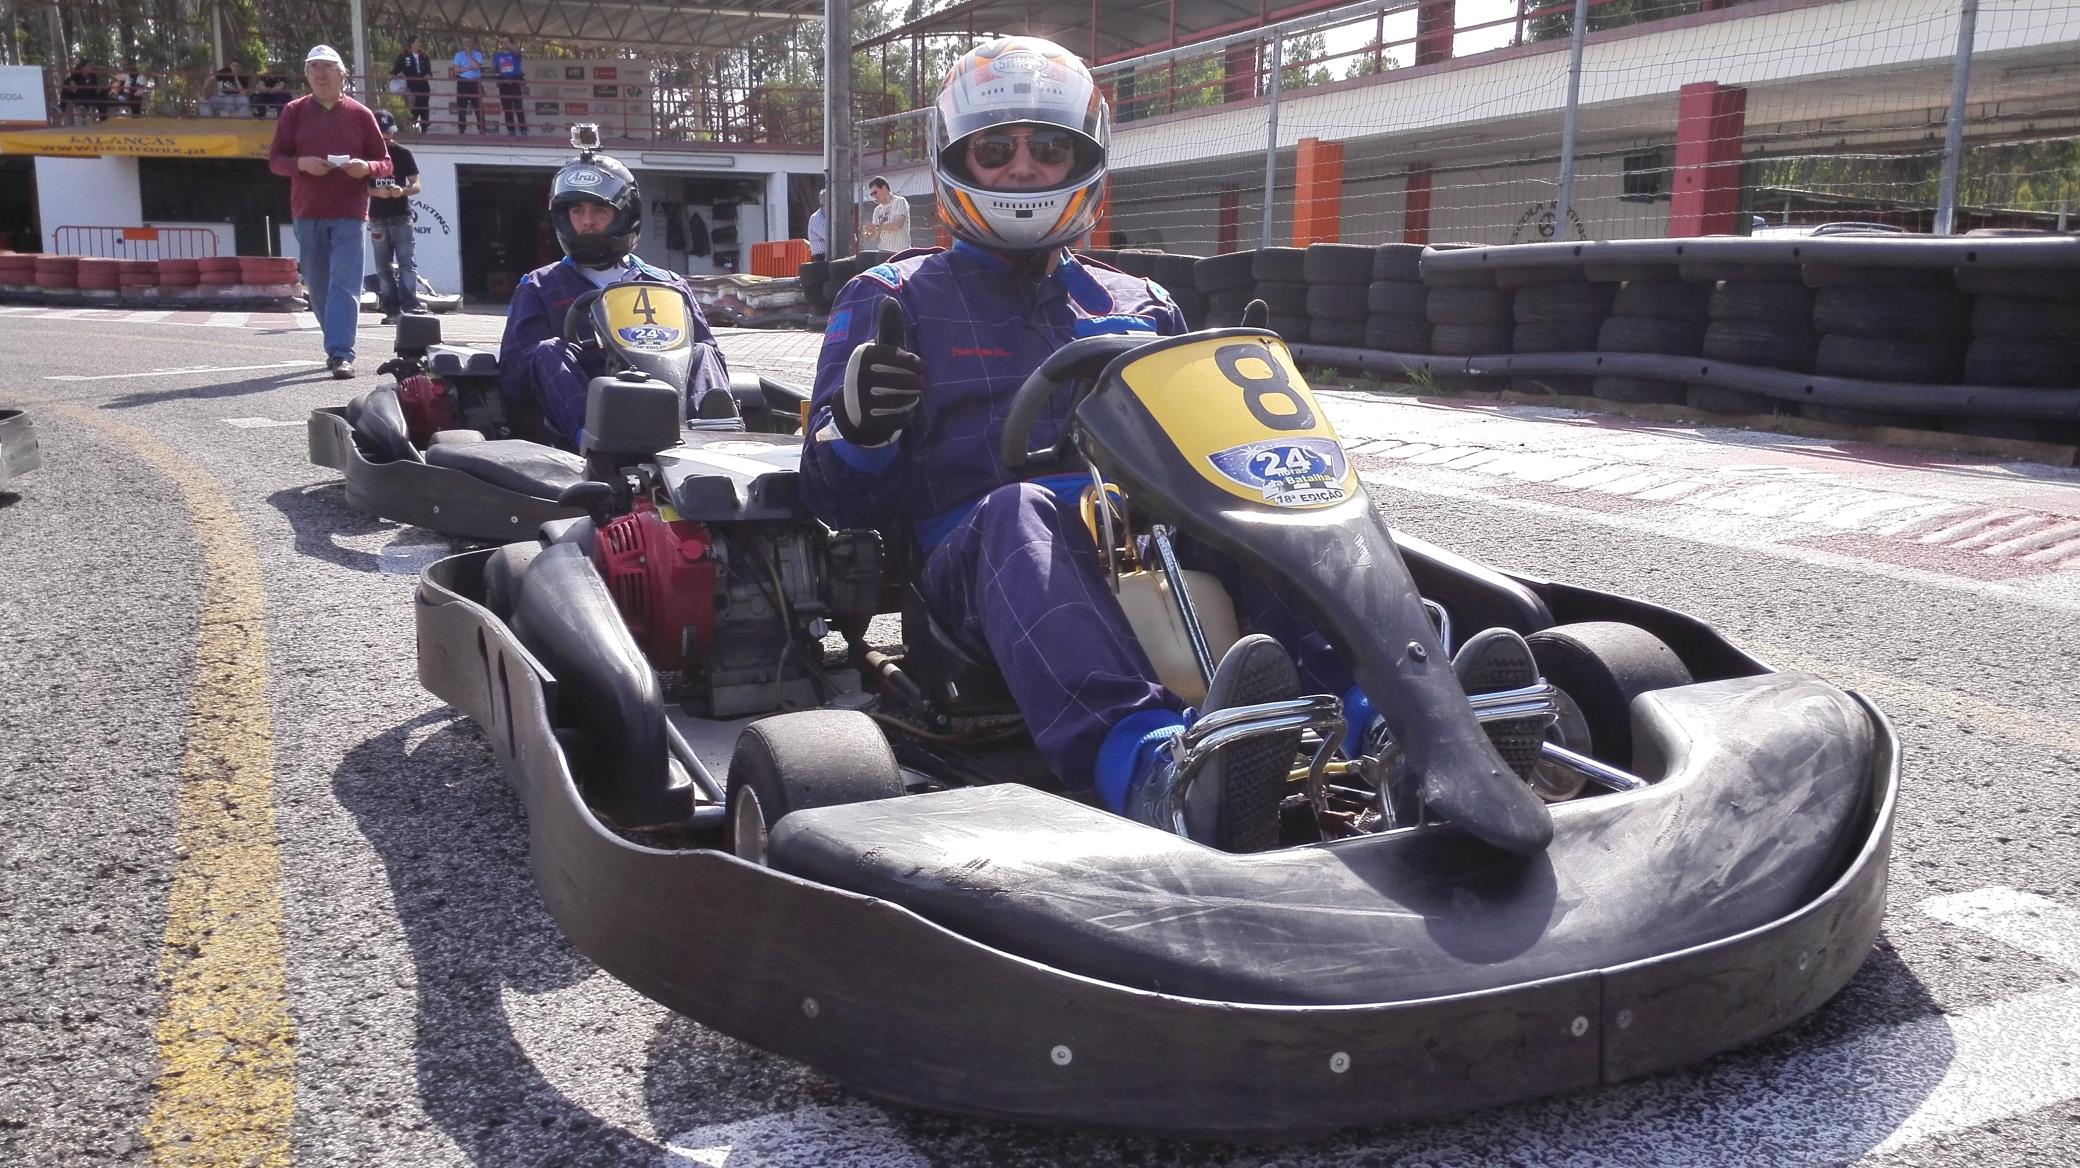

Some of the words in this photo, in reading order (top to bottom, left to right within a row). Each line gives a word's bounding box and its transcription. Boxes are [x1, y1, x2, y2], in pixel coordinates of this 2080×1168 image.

[632, 287, 658, 326] 4
[635, 328, 659, 339] 24
[1214, 343, 1317, 431] 8
[1256, 447, 1312, 477] 24
[1285, 473, 1331, 486] Batalha
[1299, 489, 1344, 502] EDIÇÃO
